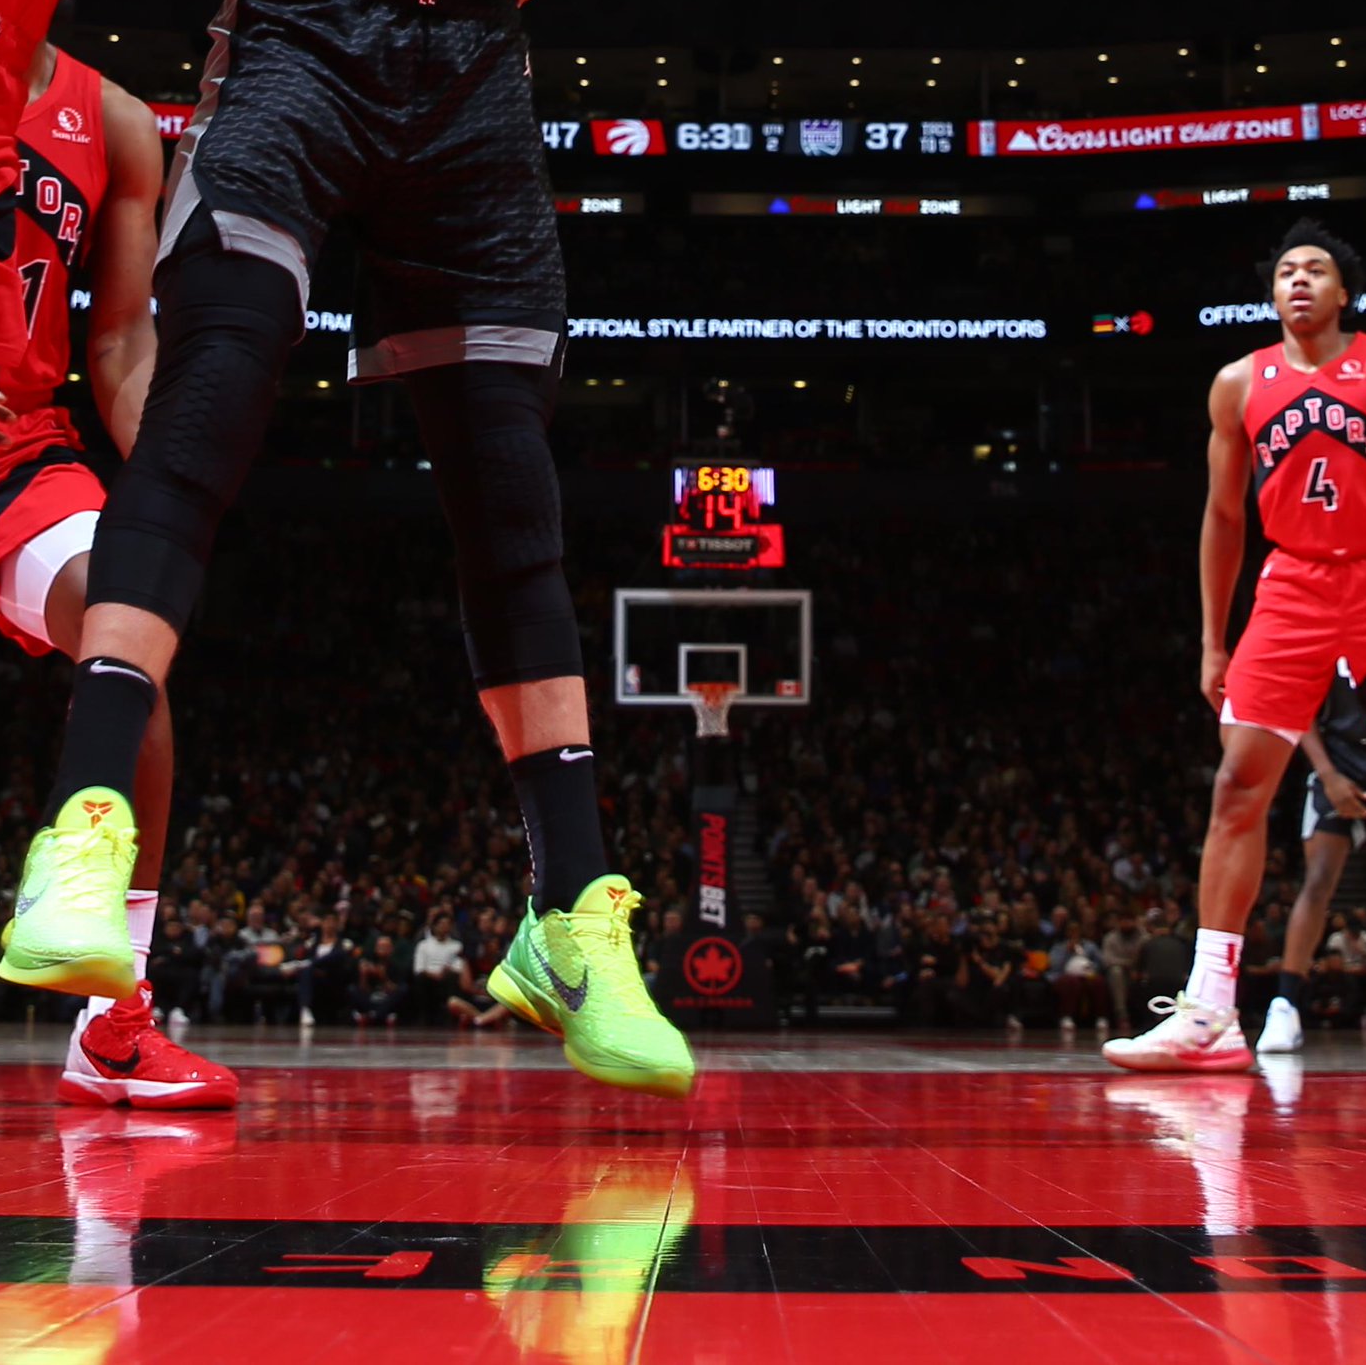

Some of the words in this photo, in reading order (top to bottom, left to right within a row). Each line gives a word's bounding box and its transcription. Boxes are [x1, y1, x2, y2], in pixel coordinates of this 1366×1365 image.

[542, 122, 580, 149] 47
[677, 122, 752, 150] 6:31
[865, 122, 909, 150] 37
[1037, 123, 1108, 152] Coors
[1109, 125, 1174, 148] LIGHT
[1234, 118, 1293, 140] ZONE
[837, 198, 882, 214] LIGHT
[920, 198, 960, 215] ZONE
[567, 319, 645, 338] OFFICIAL
[646, 319, 706, 338] STYLE
[707, 319, 794, 338] PARTNER
[794, 319, 823, 338] OF
[826, 319, 863, 338] THE
[864, 319, 958, 338] TORONTO
[958, 319, 1047, 338] RAPTORS
[697, 467, 750, 492] 6:30
[1302, 457, 1338, 513] 4
[704, 495, 742, 529] 14
[698, 538, 753, 552] TISSOT
